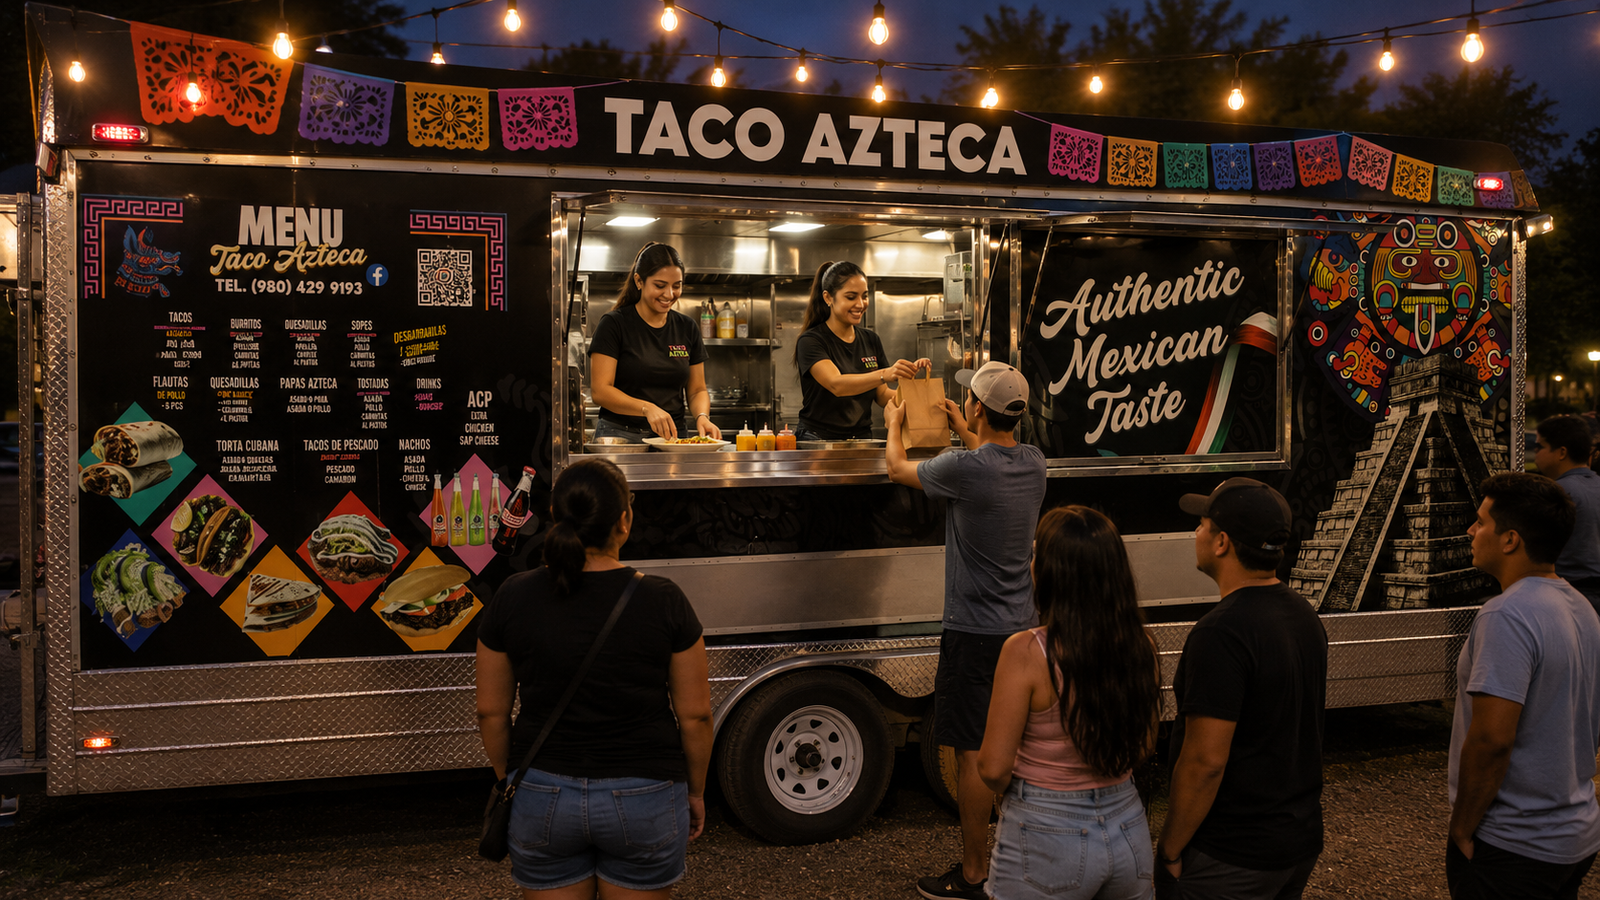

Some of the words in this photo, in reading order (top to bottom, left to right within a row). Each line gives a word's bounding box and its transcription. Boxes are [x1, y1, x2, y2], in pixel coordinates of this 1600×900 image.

[604, 97, 785, 162] TACO
[801, 113, 1028, 176] AZTECA
[238, 204, 344, 248] MENU
[209, 244, 270, 276] Taco
[274, 240, 368, 275] Azteca
[215, 278, 246, 293] TEL.
[252, 278, 291, 296] (980)
[296, 280, 324, 295] 429
[330, 281, 362, 295] 9193
[1039, 259, 1245, 340] Authentic
[168, 311, 193, 323] TACOS
[351, 319, 373, 331] SOPES
[1047, 324, 1229, 396] Mexican
[152, 375, 189, 388] FLAUTAS
[210, 376, 260, 390] QUESADILLAS
[280, 377, 305, 389] PAPAS
[308, 377, 337, 390] AZTECA
[357, 377, 390, 389] TOSTADAS
[416, 377, 442, 390] DRINKS
[157, 390, 165, 400] DE
[167, 390, 185, 400] POLLO
[467, 390, 493, 408] ACP
[171, 401, 183, 411] PCS
[1083, 380, 1187, 445] Taste
[464, 422, 495, 434] CHICKEN
[216, 439, 243, 452] TORTA
[246, 439, 279, 452] CUBANA
[302, 439, 329, 451] TACOS
[332, 439, 341, 451] DE
[344, 438, 378, 451] PESCADO
[398, 438, 431, 451] NACHOS
[475, 435, 499, 446] CHEESE
[326, 464, 356, 474] PESCADO
